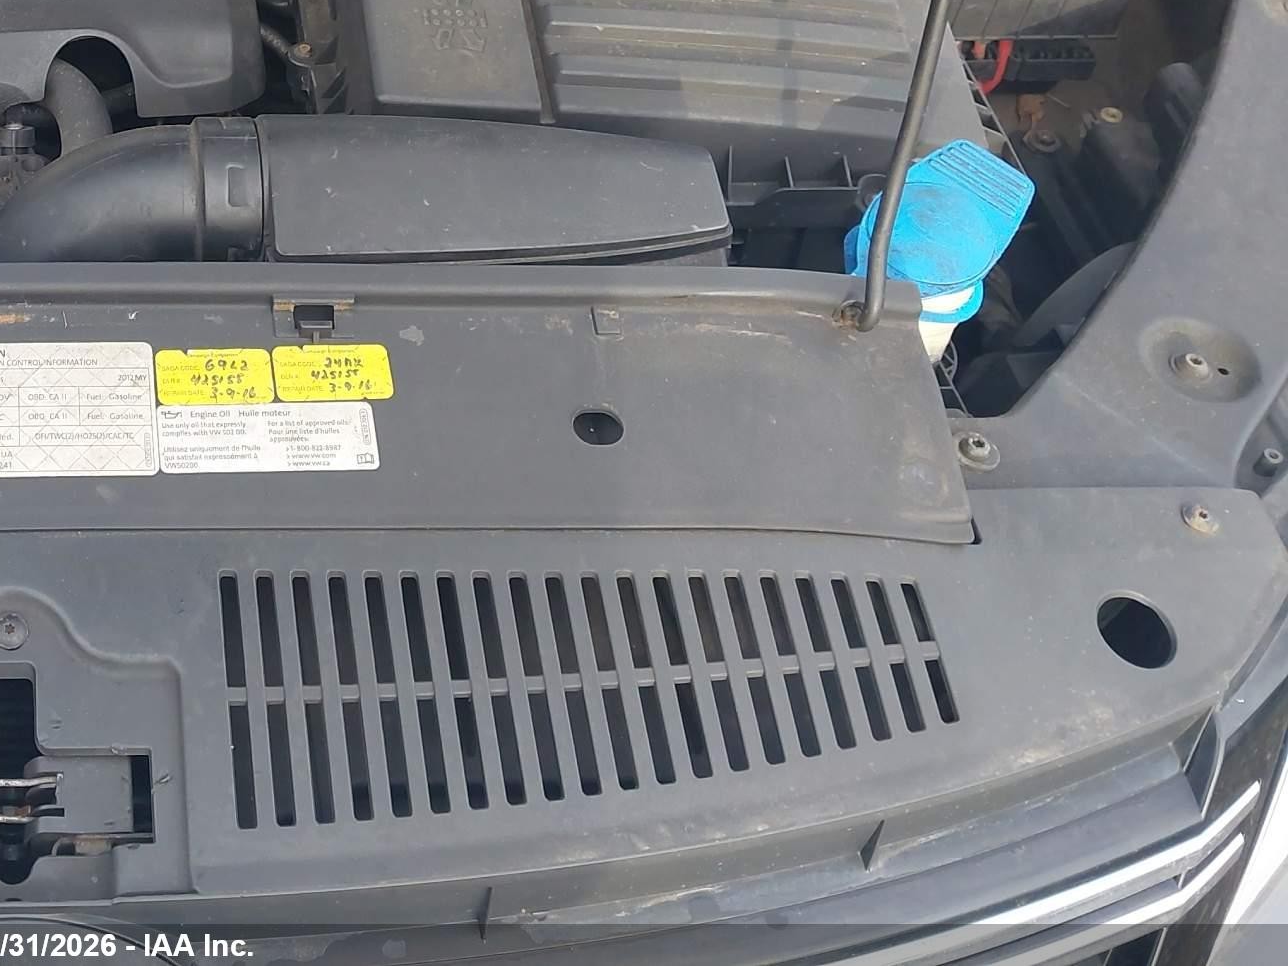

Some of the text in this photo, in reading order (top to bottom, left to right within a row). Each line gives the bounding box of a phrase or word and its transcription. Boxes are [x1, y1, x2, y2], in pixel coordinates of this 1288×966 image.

[6, 359, 42, 367] CONTROL
[44, 358, 98, 366] INFORMATION
[190, 410, 231, 420] Engine Oil
